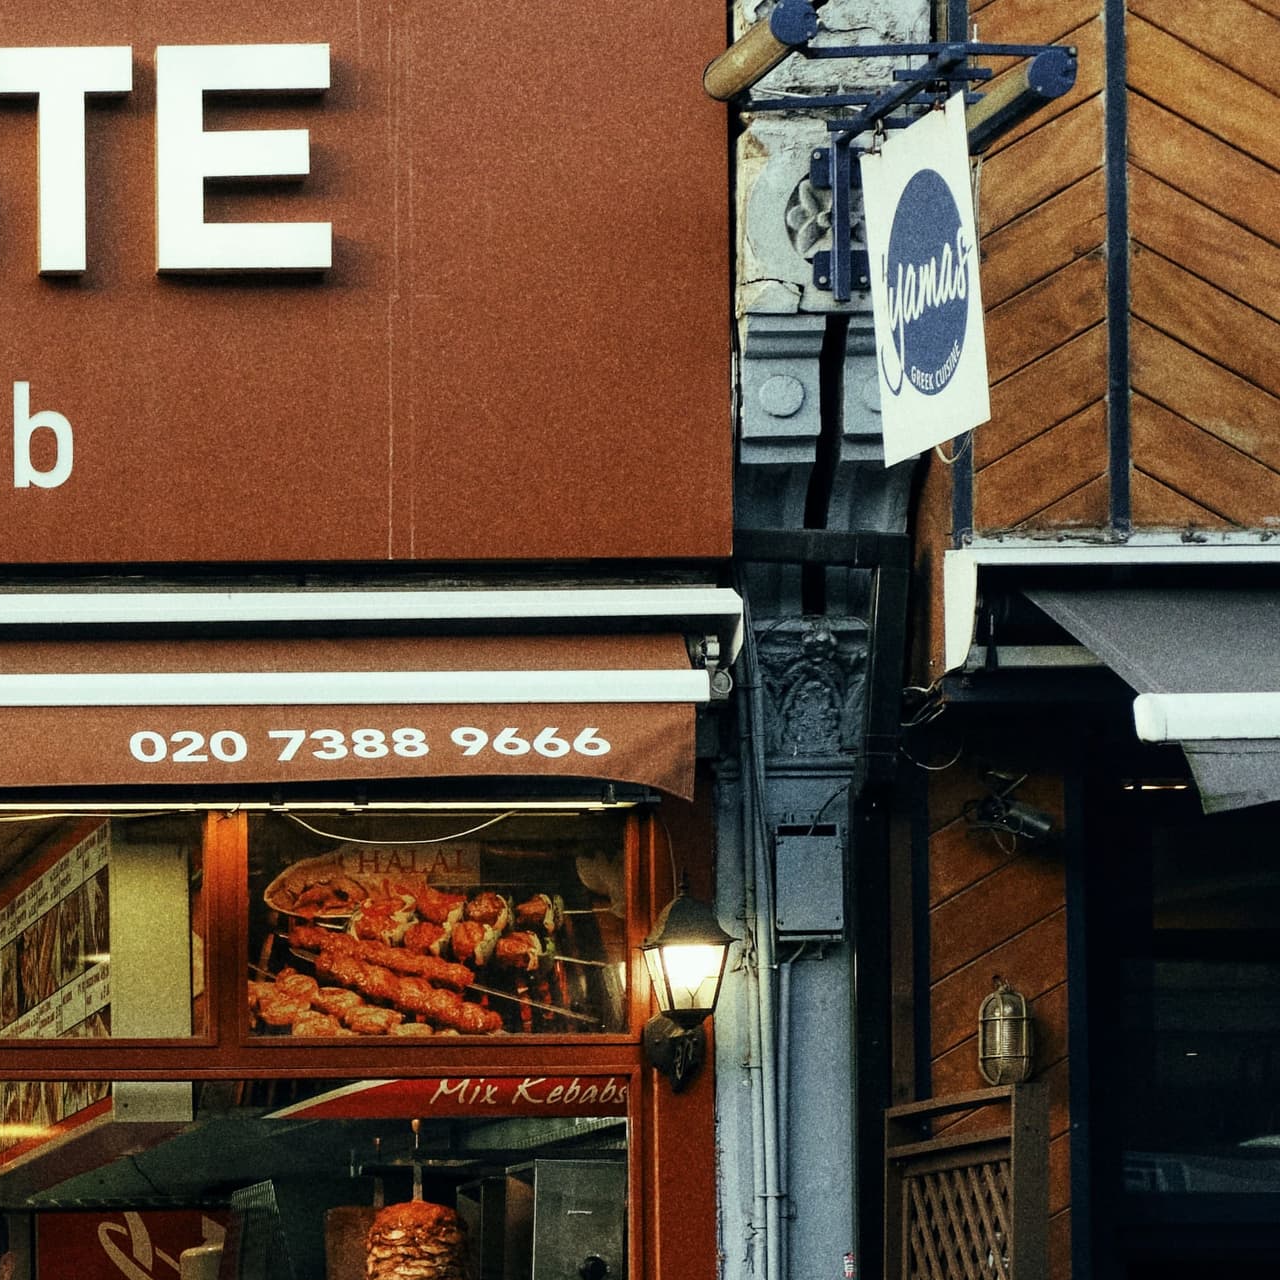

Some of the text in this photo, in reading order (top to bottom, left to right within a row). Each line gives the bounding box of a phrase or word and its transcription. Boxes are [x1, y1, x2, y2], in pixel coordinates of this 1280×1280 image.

[910, 340, 960, 391] GREEK CUISINE
[129, 725, 612, 764] 020 7388 9666
[357, 848, 467, 874] HALAL
[429, 1076, 628, 1105] Mix Kebabs
